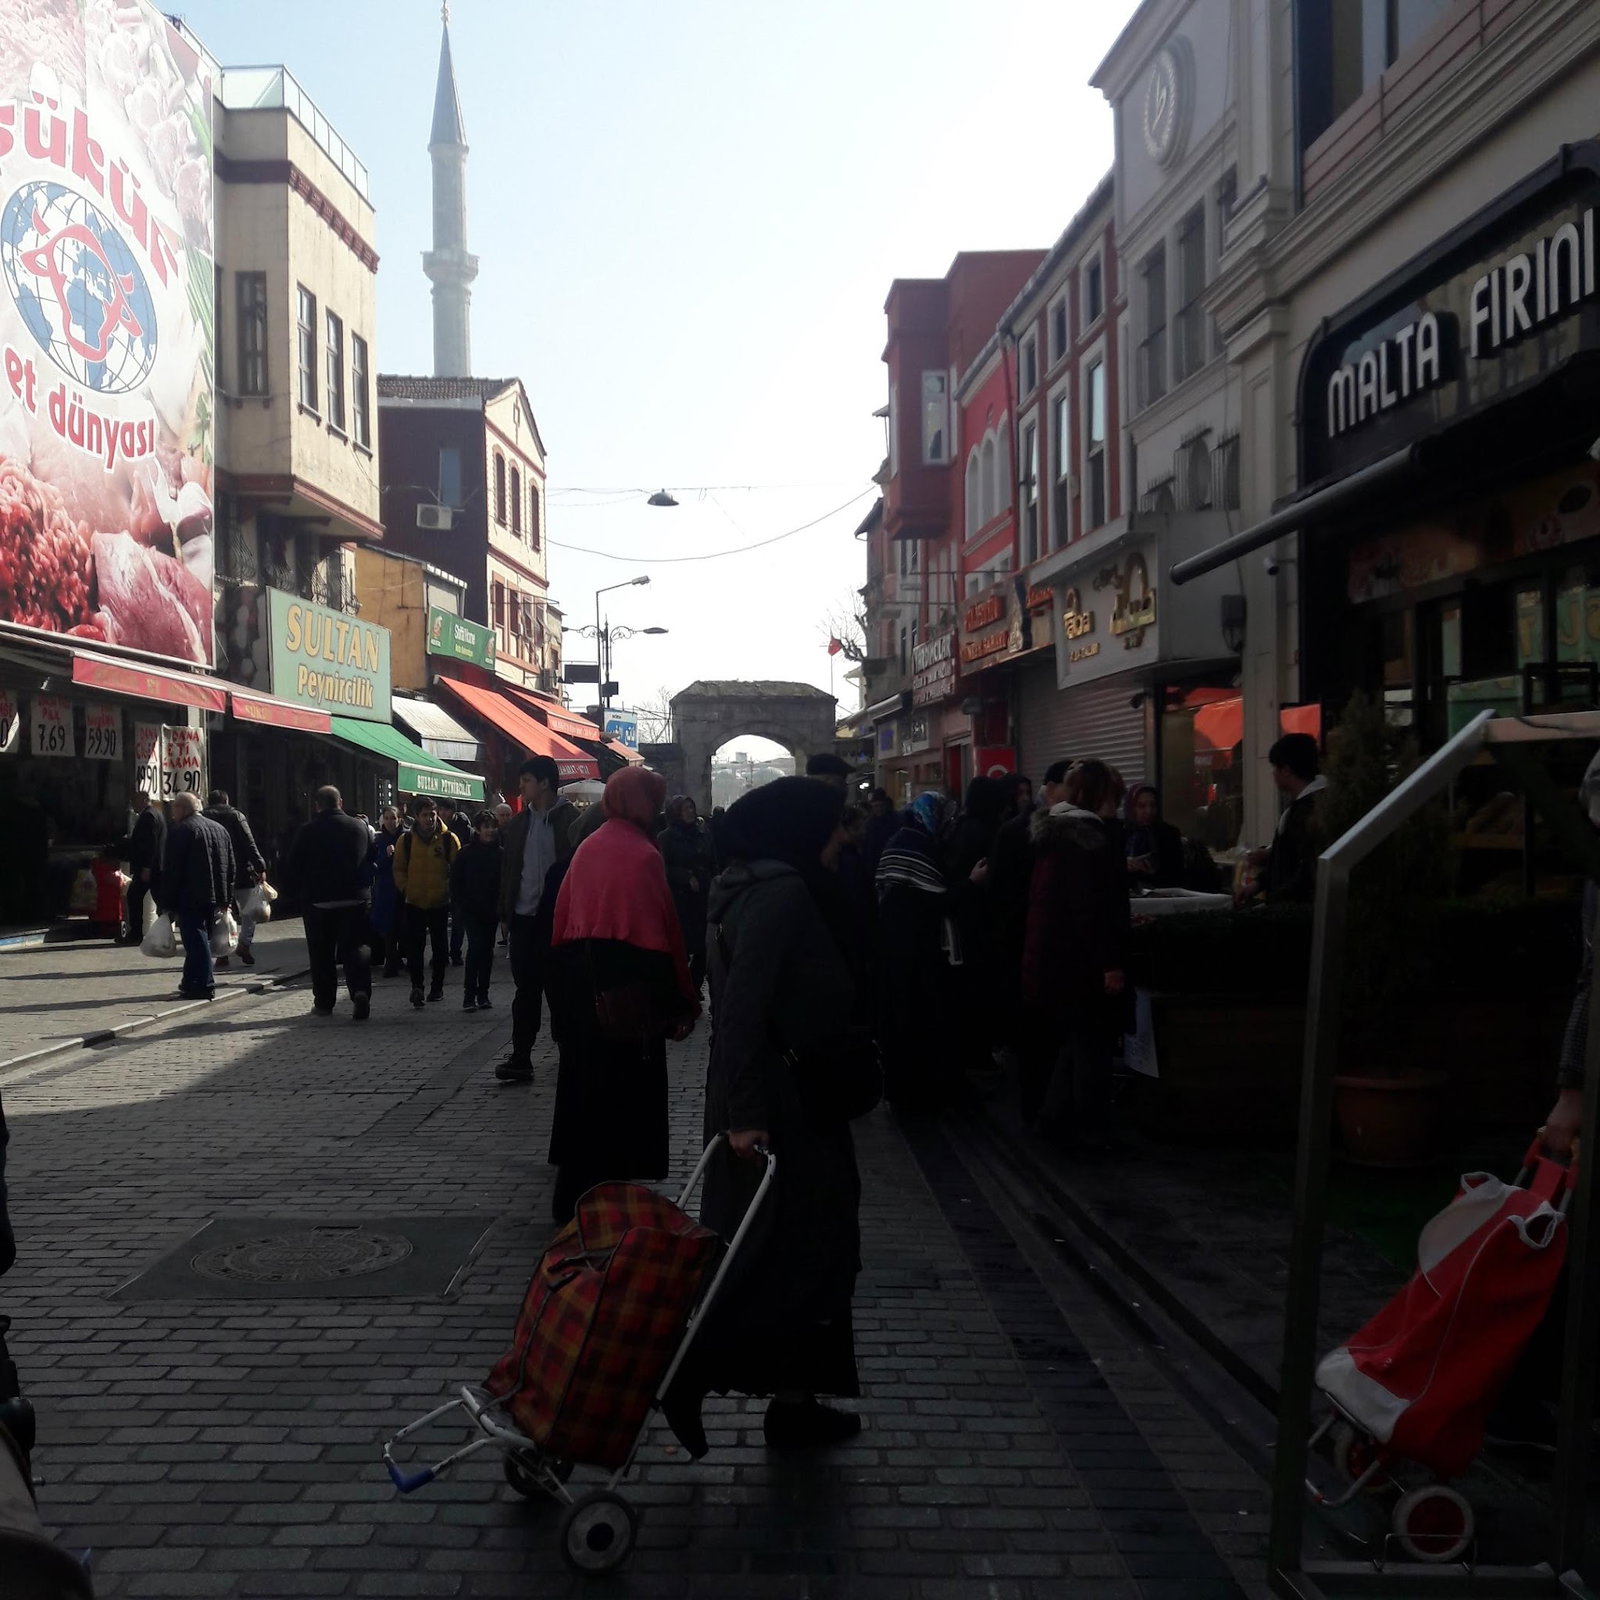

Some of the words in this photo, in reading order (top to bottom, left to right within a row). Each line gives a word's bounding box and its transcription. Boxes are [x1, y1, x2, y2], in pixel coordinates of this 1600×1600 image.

[1327, 311, 1440, 439] MALTA
[1470, 207, 1595, 359] FIRINI
[5, 347, 36, 413] et
[49, 382, 154, 469] dünyası
[286, 604, 379, 673] SULTAN
[297, 664, 373, 709] Peynircilik
